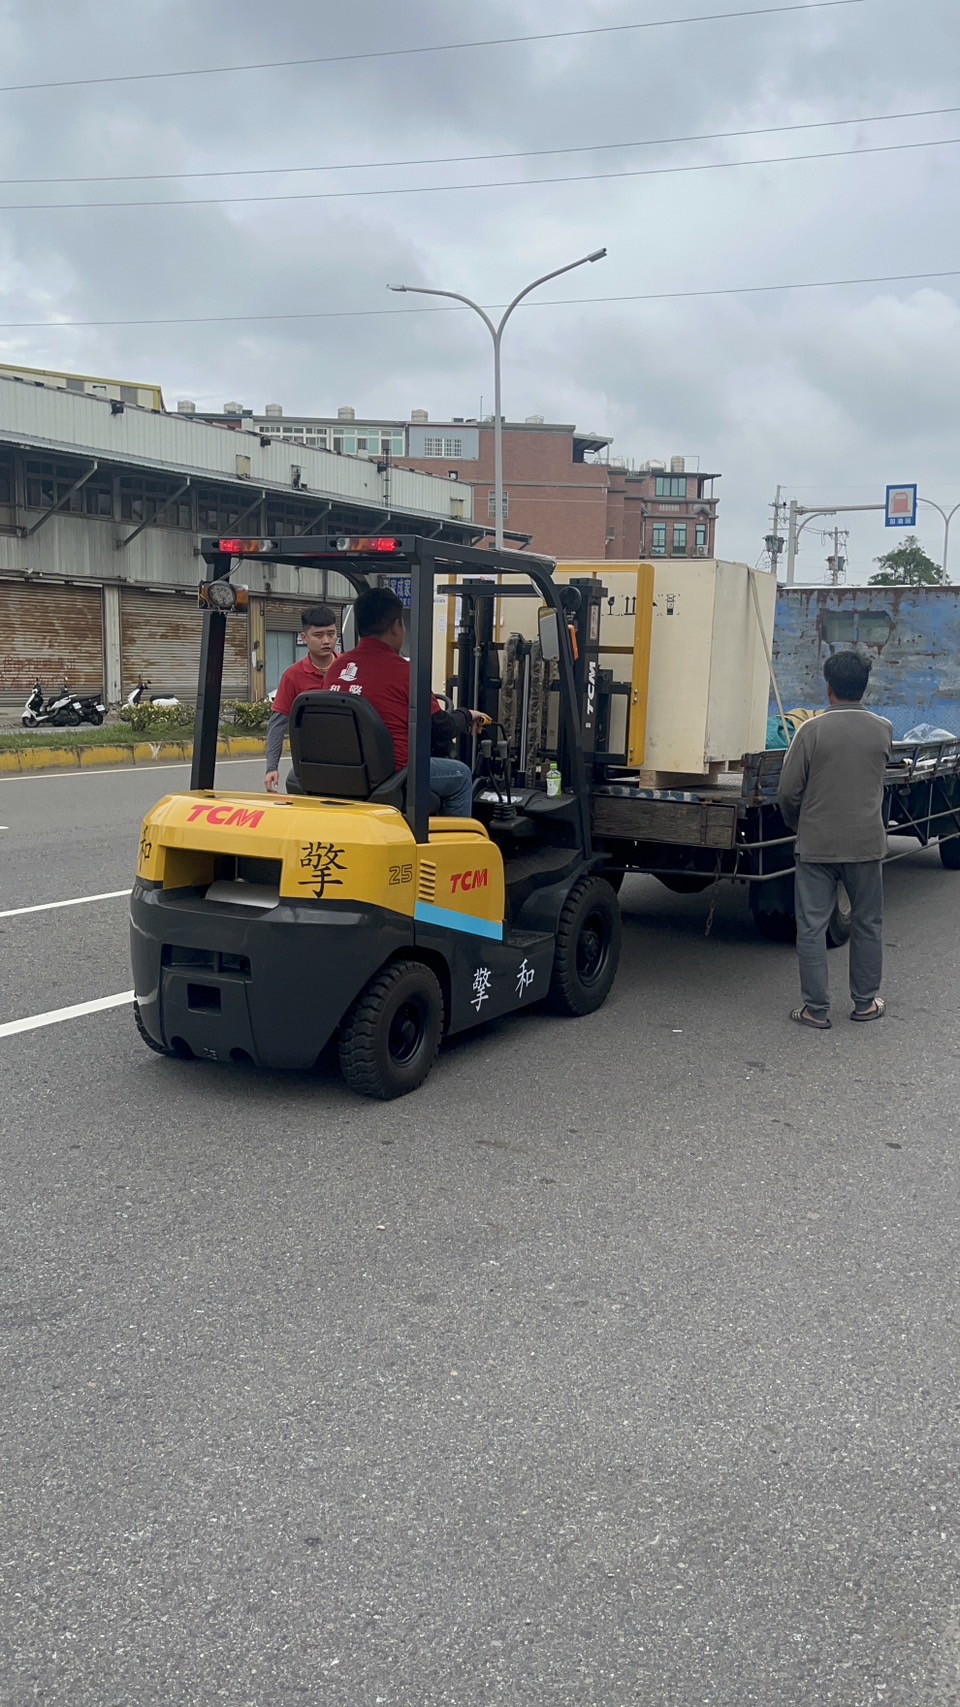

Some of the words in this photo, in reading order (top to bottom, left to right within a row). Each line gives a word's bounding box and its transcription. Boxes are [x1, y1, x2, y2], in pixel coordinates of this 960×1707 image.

[586, 661, 596, 715] TCM
[186, 804, 265, 829] TCM
[298, 842, 348, 898] 擎
[389, 864, 413, 885] 25
[450, 869, 488, 893] TCM
[515, 958, 535, 998] 和
